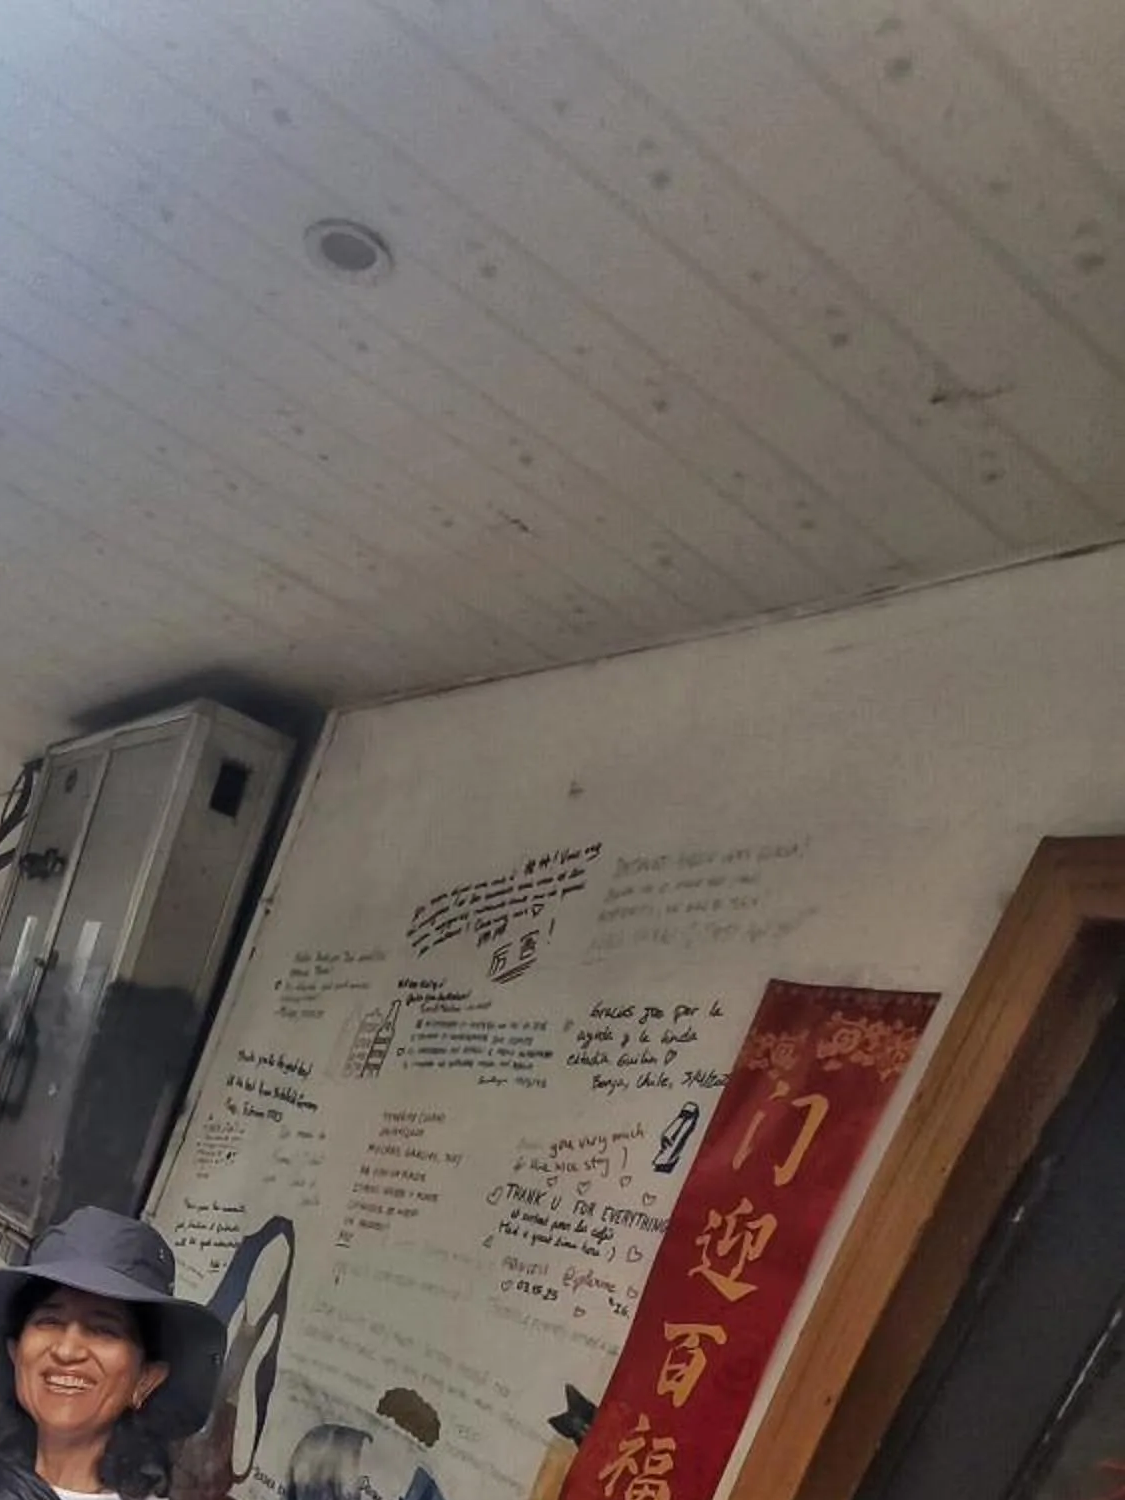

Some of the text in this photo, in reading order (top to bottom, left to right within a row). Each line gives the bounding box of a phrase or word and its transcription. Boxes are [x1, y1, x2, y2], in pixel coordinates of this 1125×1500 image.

[611, 1121, 647, 1144] much
[505, 1183, 548, 1207] THANK
[550, 1194, 562, 1211] U
[572, 1199, 597, 1217] FOR
